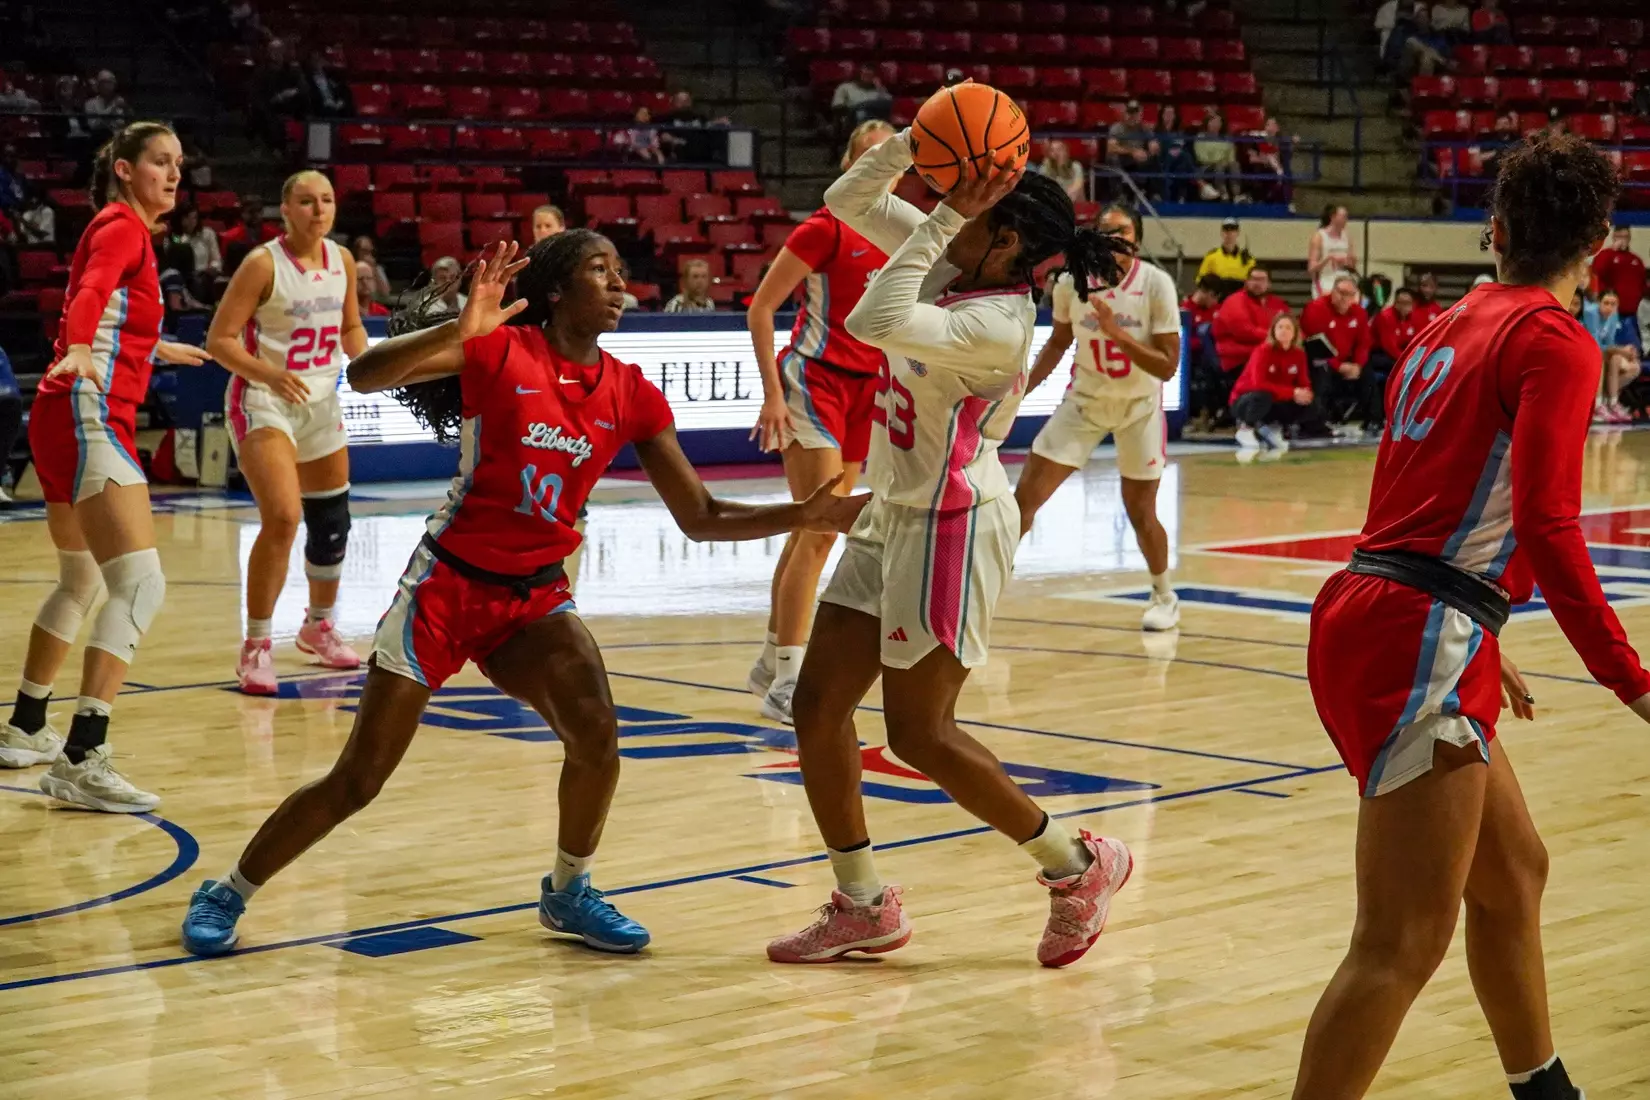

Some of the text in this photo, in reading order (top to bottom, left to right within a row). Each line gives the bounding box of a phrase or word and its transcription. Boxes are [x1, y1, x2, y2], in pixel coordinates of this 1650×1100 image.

[285, 325, 340, 371] 25
[1088, 339, 1132, 379] 15
[660, 360, 752, 402] FUEL
[1391, 346, 1455, 442] 12
[521, 422, 594, 468] Liberty
[513, 463, 564, 523] 10
